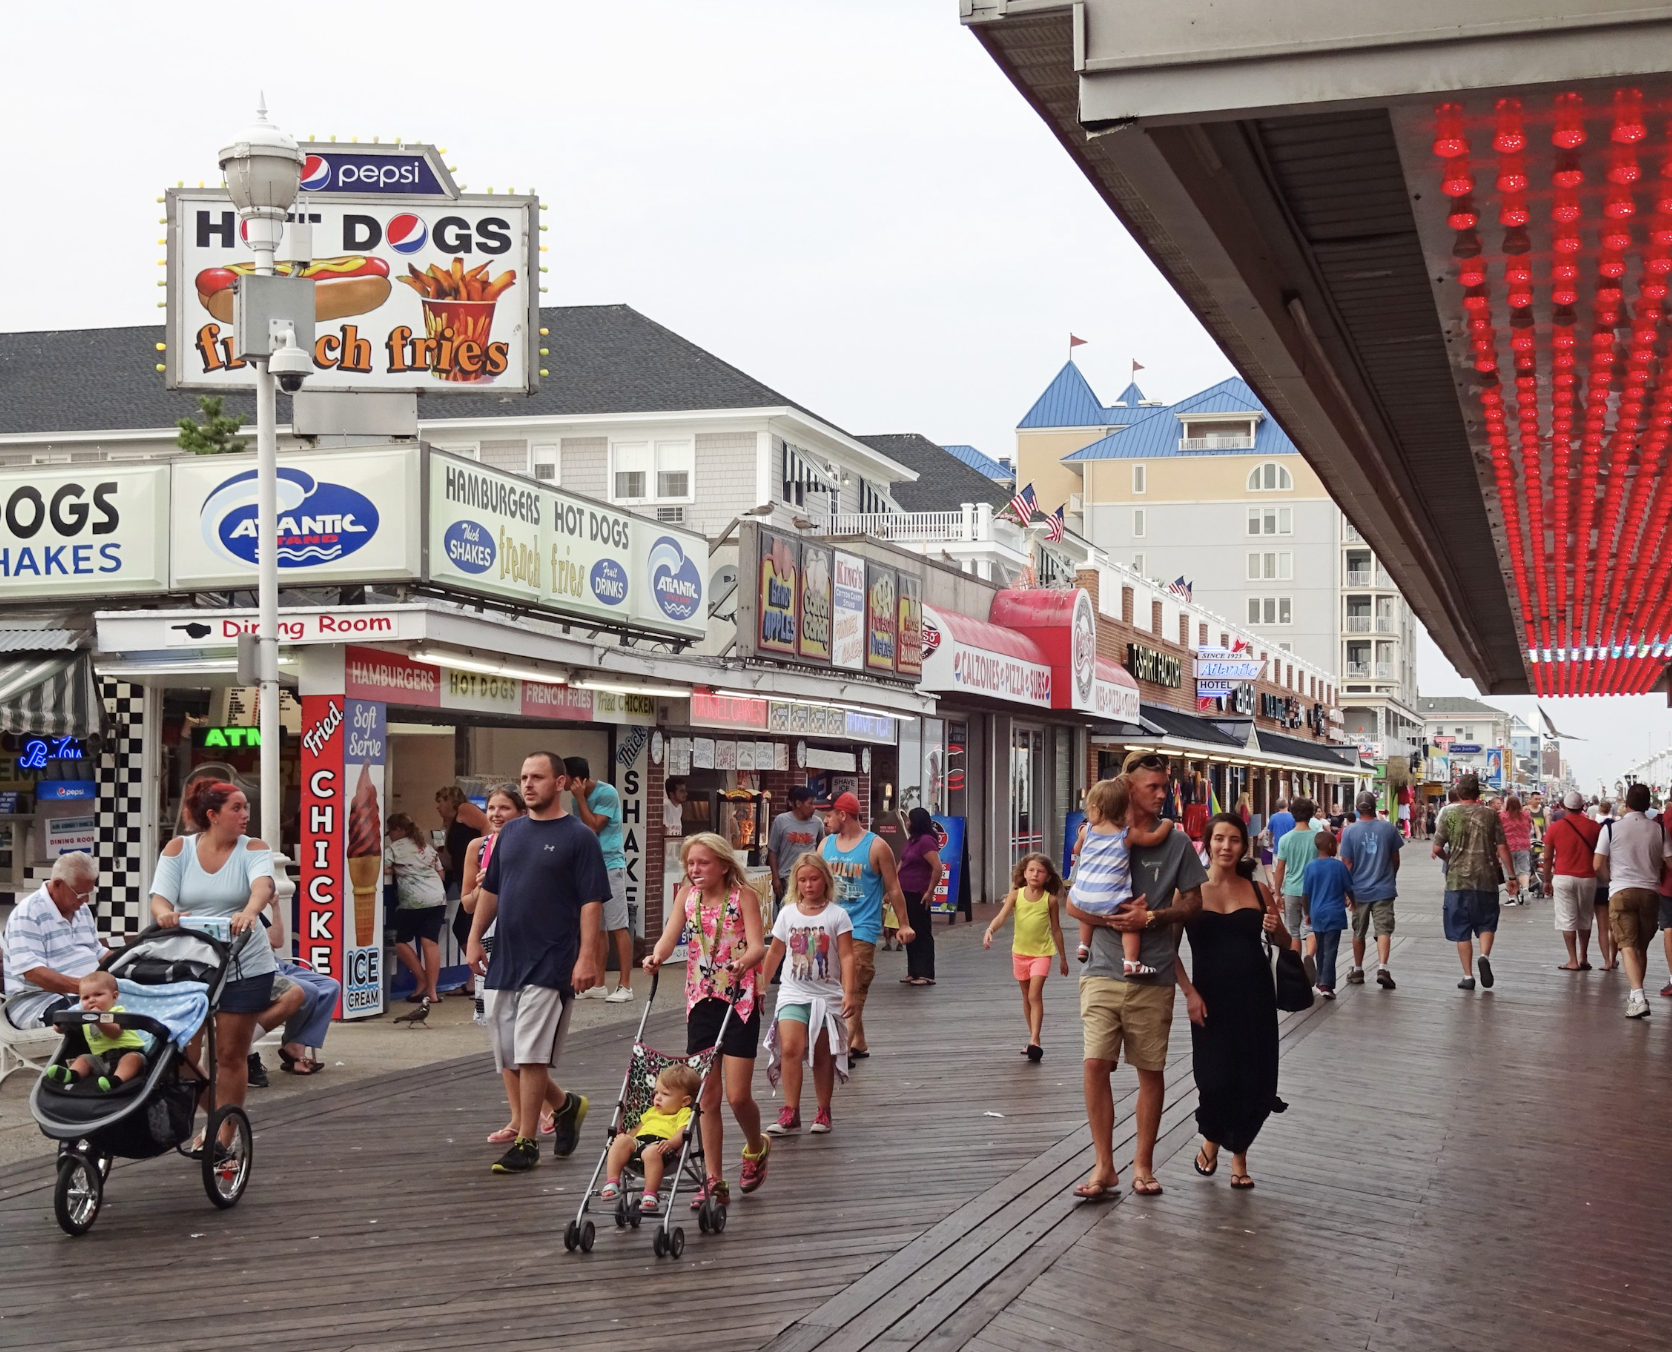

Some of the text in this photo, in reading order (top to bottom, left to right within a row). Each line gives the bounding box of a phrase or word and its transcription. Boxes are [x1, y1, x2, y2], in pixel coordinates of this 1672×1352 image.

[338, 162, 418, 186] pepsi
[196, 322, 509, 376] frch fries
[446, 466, 540, 526] HAMBURGERS
[0, 482, 120, 539] OGS
[462, 523, 479, 542] Thick
[554, 501, 628, 550] HOT DOGS
[450, 540, 491, 567] SHAKES
[499, 524, 584, 598] french fries
[595, 580, 624, 599] DRINKS
[656, 576, 698, 600] ATLANTIC
[223, 615, 392, 640] Dinng Room
[352, 666, 434, 692] HAMBURGERS
[962, 651, 1046, 700] CALZONES PIZZA SUBS
[1200, 662, 1258, 676] Atlantic
[450, 674, 516, 700] HOT DOGS
[526, 684, 592, 708] FRENCH FRIES
[1200, 680, 1232, 689] HOTEL
[618, 694, 654, 715] CHICKEN
[303, 701, 344, 757] Fried
[354, 704, 377, 740] Soft
[350, 733, 382, 757] Serve
[618, 726, 648, 769] Thick
[66, 788, 85, 797] pepsi
[834, 779, 856, 787] SHAVE
[50, 838, 74, 846] DINING
[348, 951, 378, 986] ICE
[348, 989, 379, 1008] CREAM
